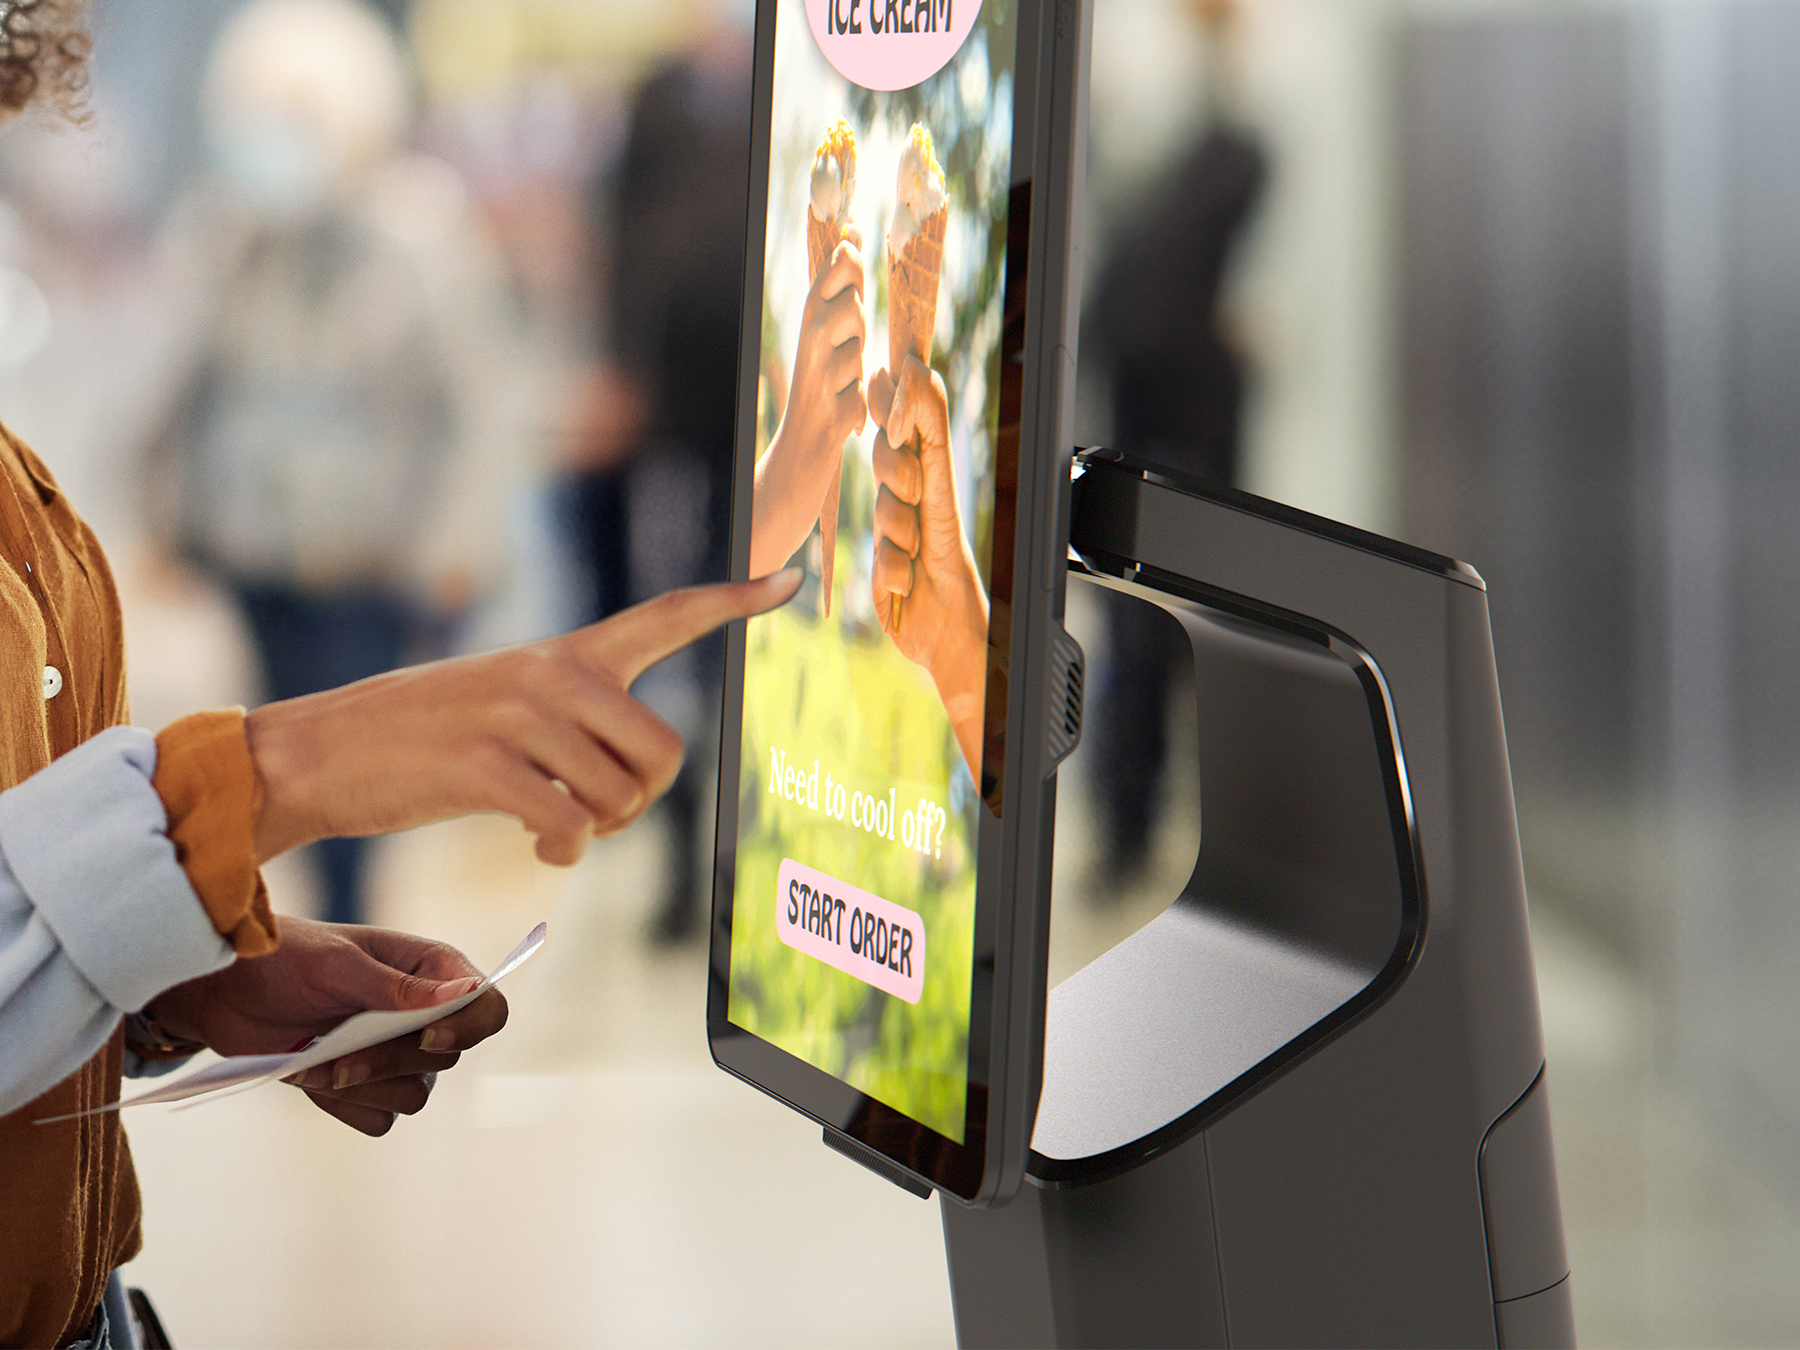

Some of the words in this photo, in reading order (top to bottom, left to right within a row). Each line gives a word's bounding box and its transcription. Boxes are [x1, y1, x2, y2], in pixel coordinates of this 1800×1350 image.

[768, 746, 820, 811] Need
[825, 771, 846, 820] to
[851, 787, 896, 841] cool
[902, 797, 946, 860] off?
[787, 879, 846, 946] START
[850, 907, 913, 978] ORDER
